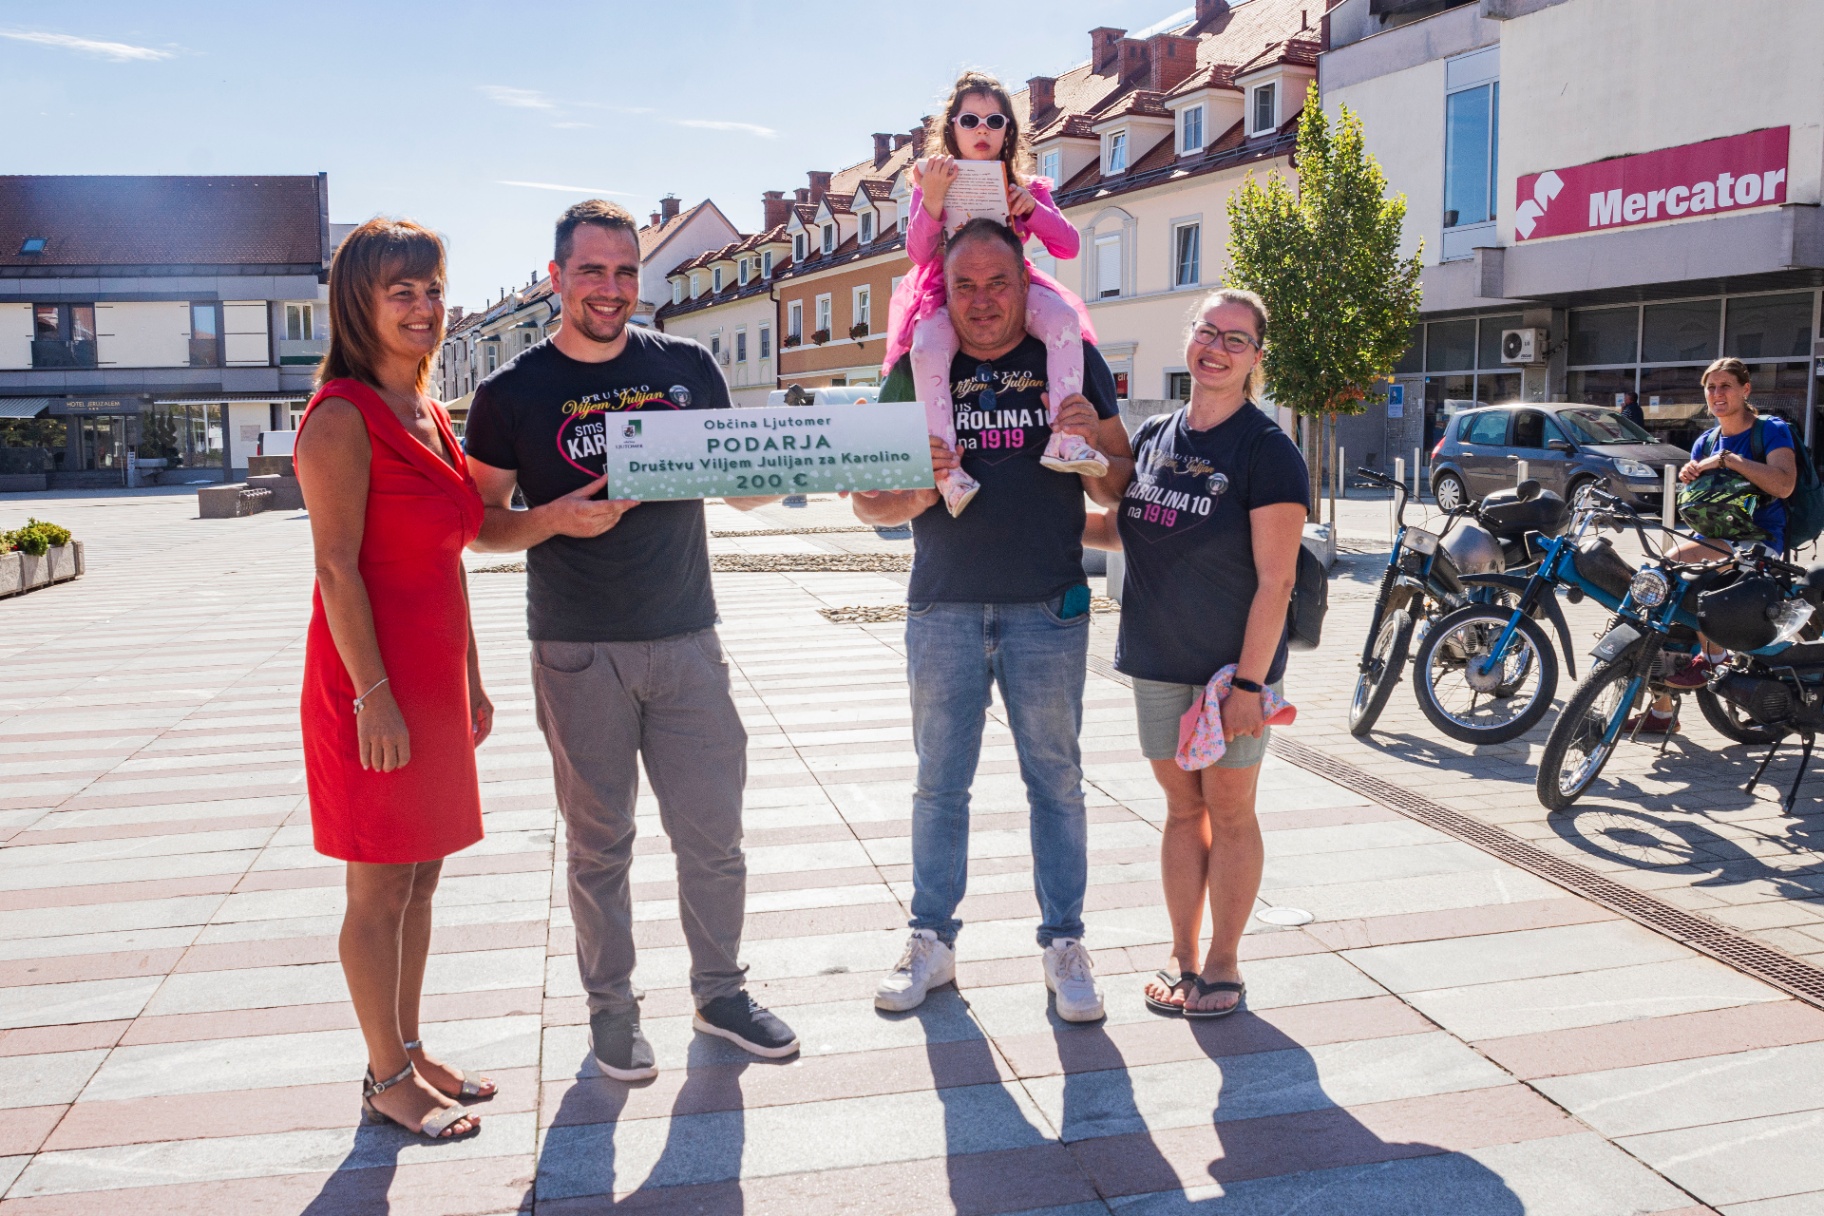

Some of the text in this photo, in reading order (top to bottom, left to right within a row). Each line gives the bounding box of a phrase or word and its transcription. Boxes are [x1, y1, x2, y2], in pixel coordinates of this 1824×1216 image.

[1588, 168, 1786, 227] Mercator
[562, 389, 664, 419] Viljem Julijan
[581, 384, 650, 403] DRUŠTVO
[574, 422, 604, 437] sms
[704, 417, 831, 430] Občina Ljutomer
[956, 409, 1033, 430] ROLINA
[567, 433, 607, 460] KAR
[707, 434, 831, 453] PODARJA
[979, 428, 1025, 449] 1919
[629, 451, 910, 473] Društvu Viljem Julijan za Karolino
[736, 473, 808, 489] 200 €
[1127, 503, 1178, 528] na 1919
[1191, 495, 1212, 516] 10
